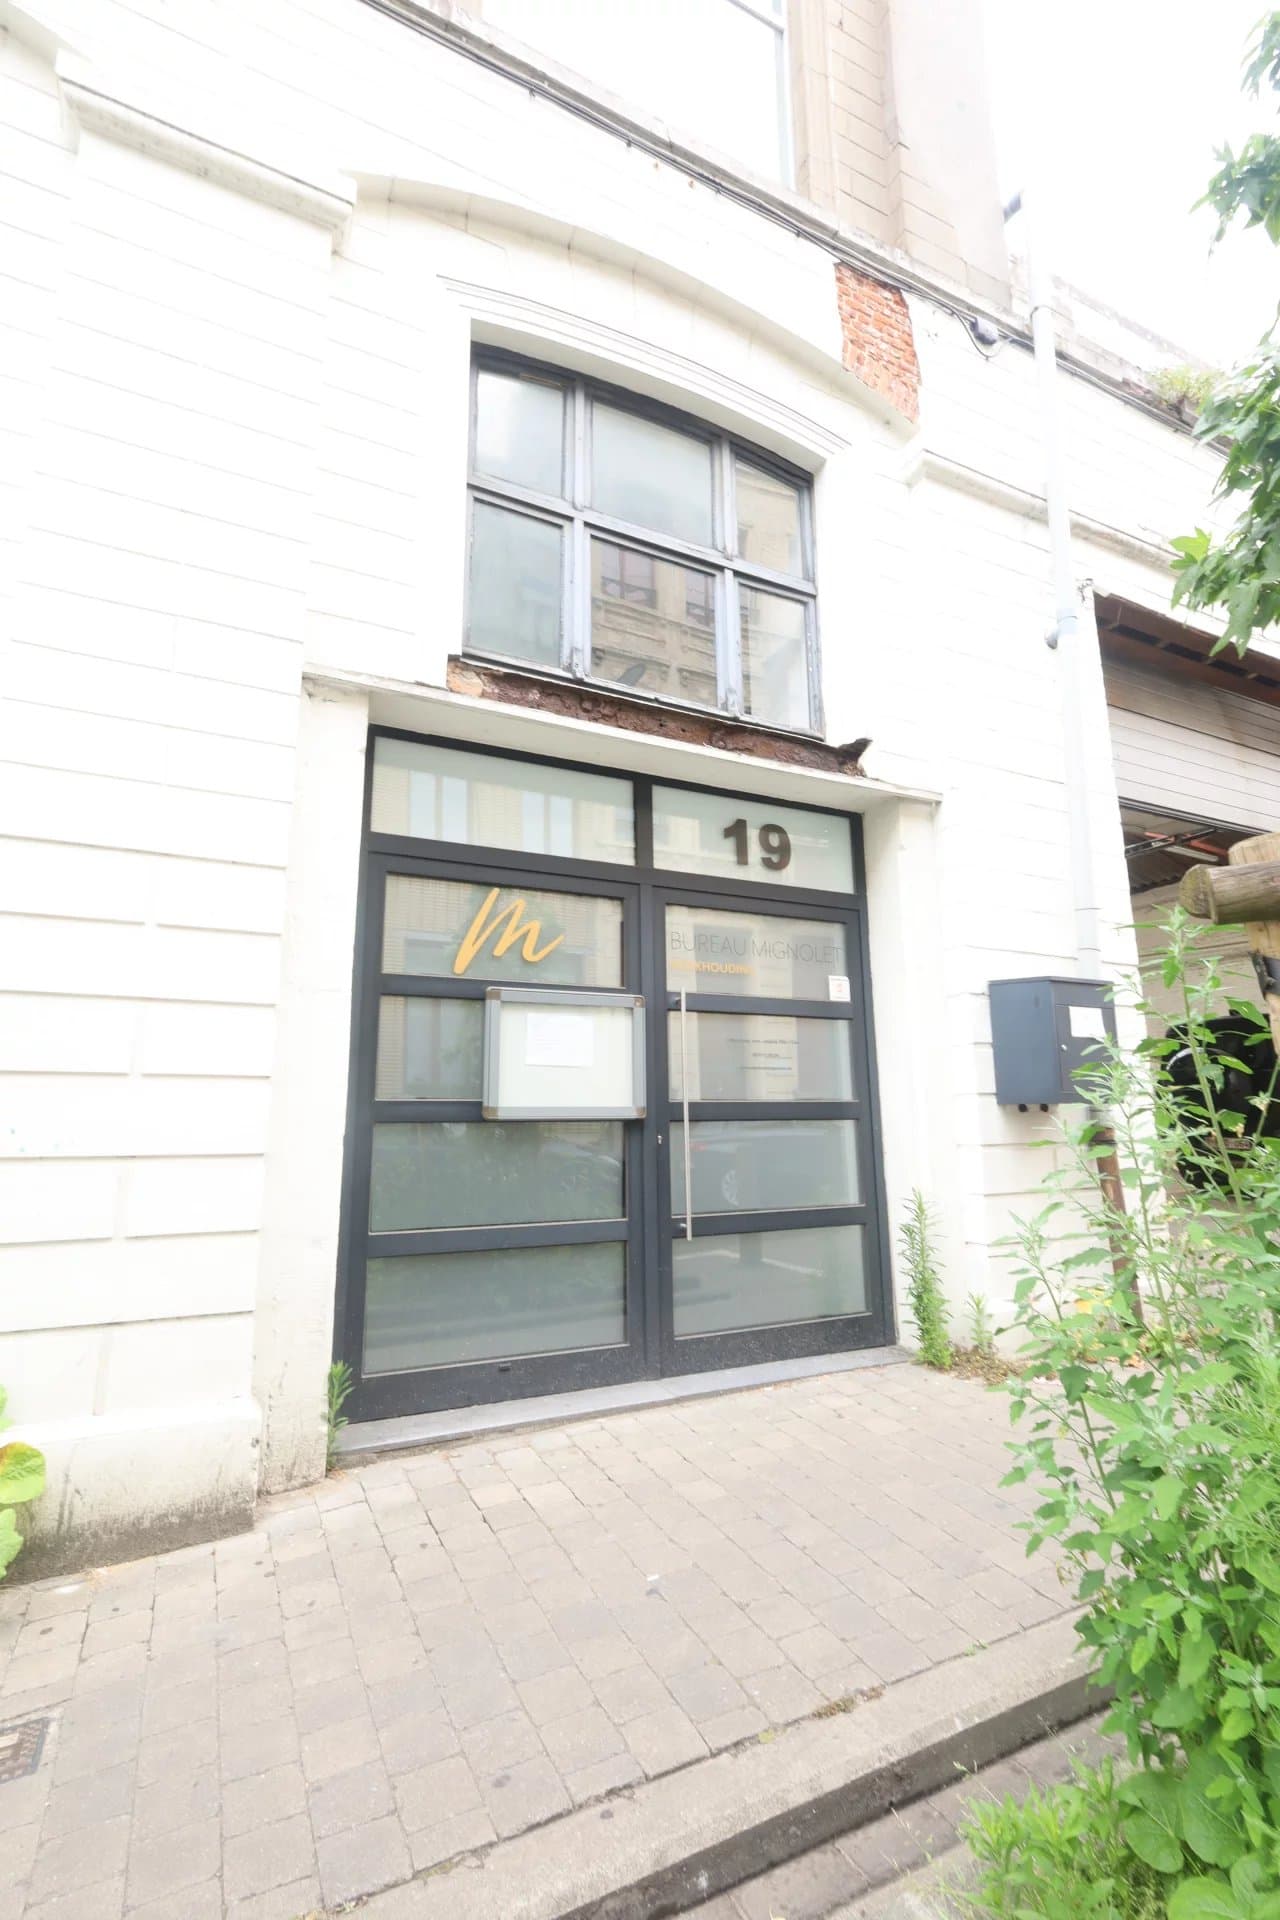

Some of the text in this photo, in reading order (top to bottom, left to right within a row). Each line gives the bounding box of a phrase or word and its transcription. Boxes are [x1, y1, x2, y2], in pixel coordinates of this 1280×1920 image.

[723, 818, 792, 871] 19
[671, 931, 842, 966] BUREAU MIGNOLET
